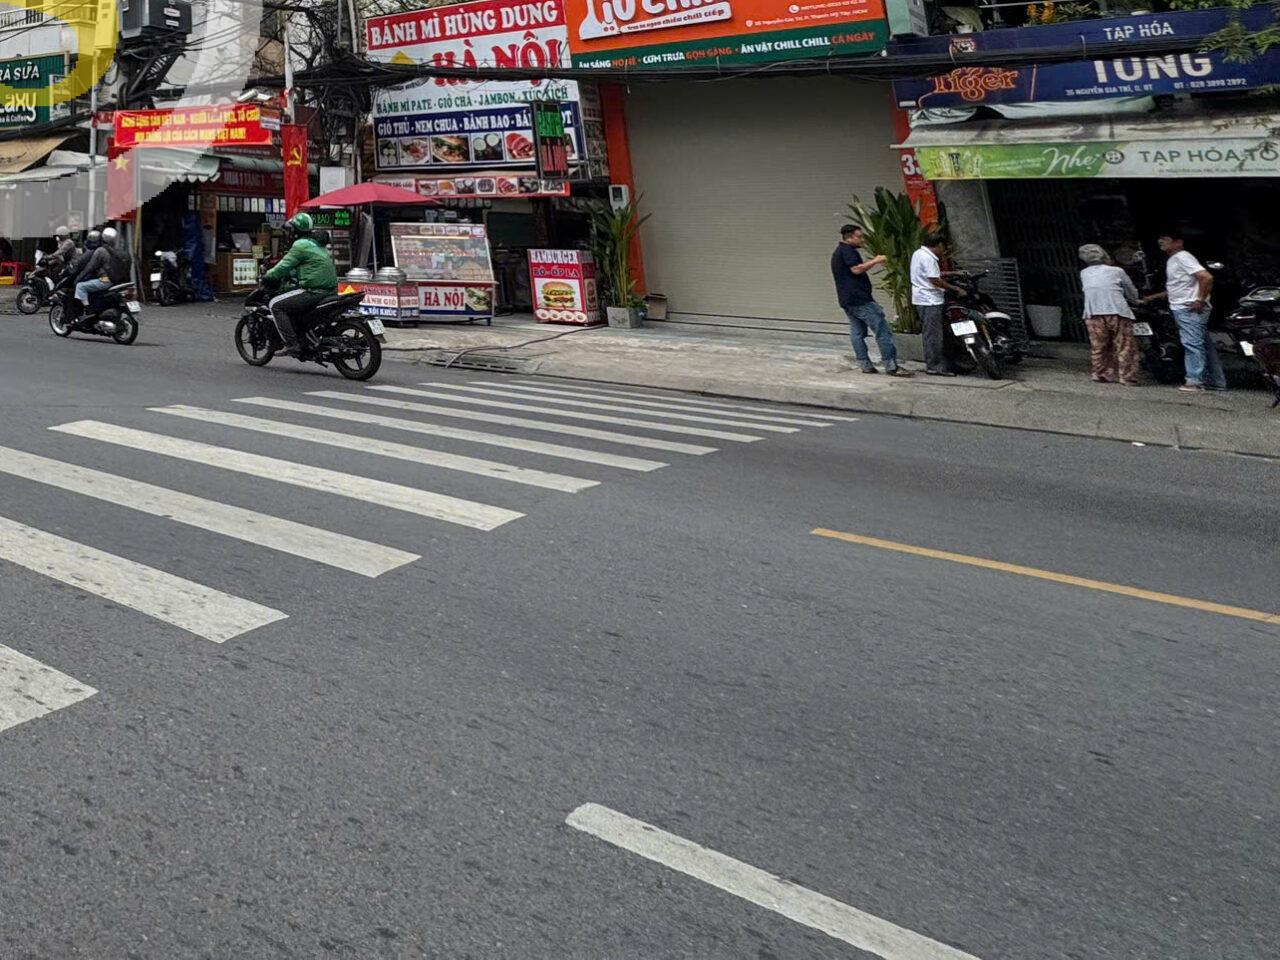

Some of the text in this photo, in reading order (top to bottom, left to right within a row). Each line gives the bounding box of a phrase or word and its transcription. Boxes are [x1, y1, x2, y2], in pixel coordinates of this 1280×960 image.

[370, 0, 558, 46] BÁNH MÌ HÙNG DUNG
[1103, 20, 1175, 42] TẠP HÓA
[774, 40, 801, 50] CHILL
[802, 36, 830, 47] CHILL
[927, 67, 1019, 101] Tiger
[411, 98, 432, 111] PATE
[478, 91, 516, 106] JAMBON
[415, 119, 433, 133] NEM
[434, 116, 459, 132] CHUA
[490, 113, 510, 129] BAO
[424, 288, 441, 307] HÀ
[443, 288, 464, 310] NỘI
